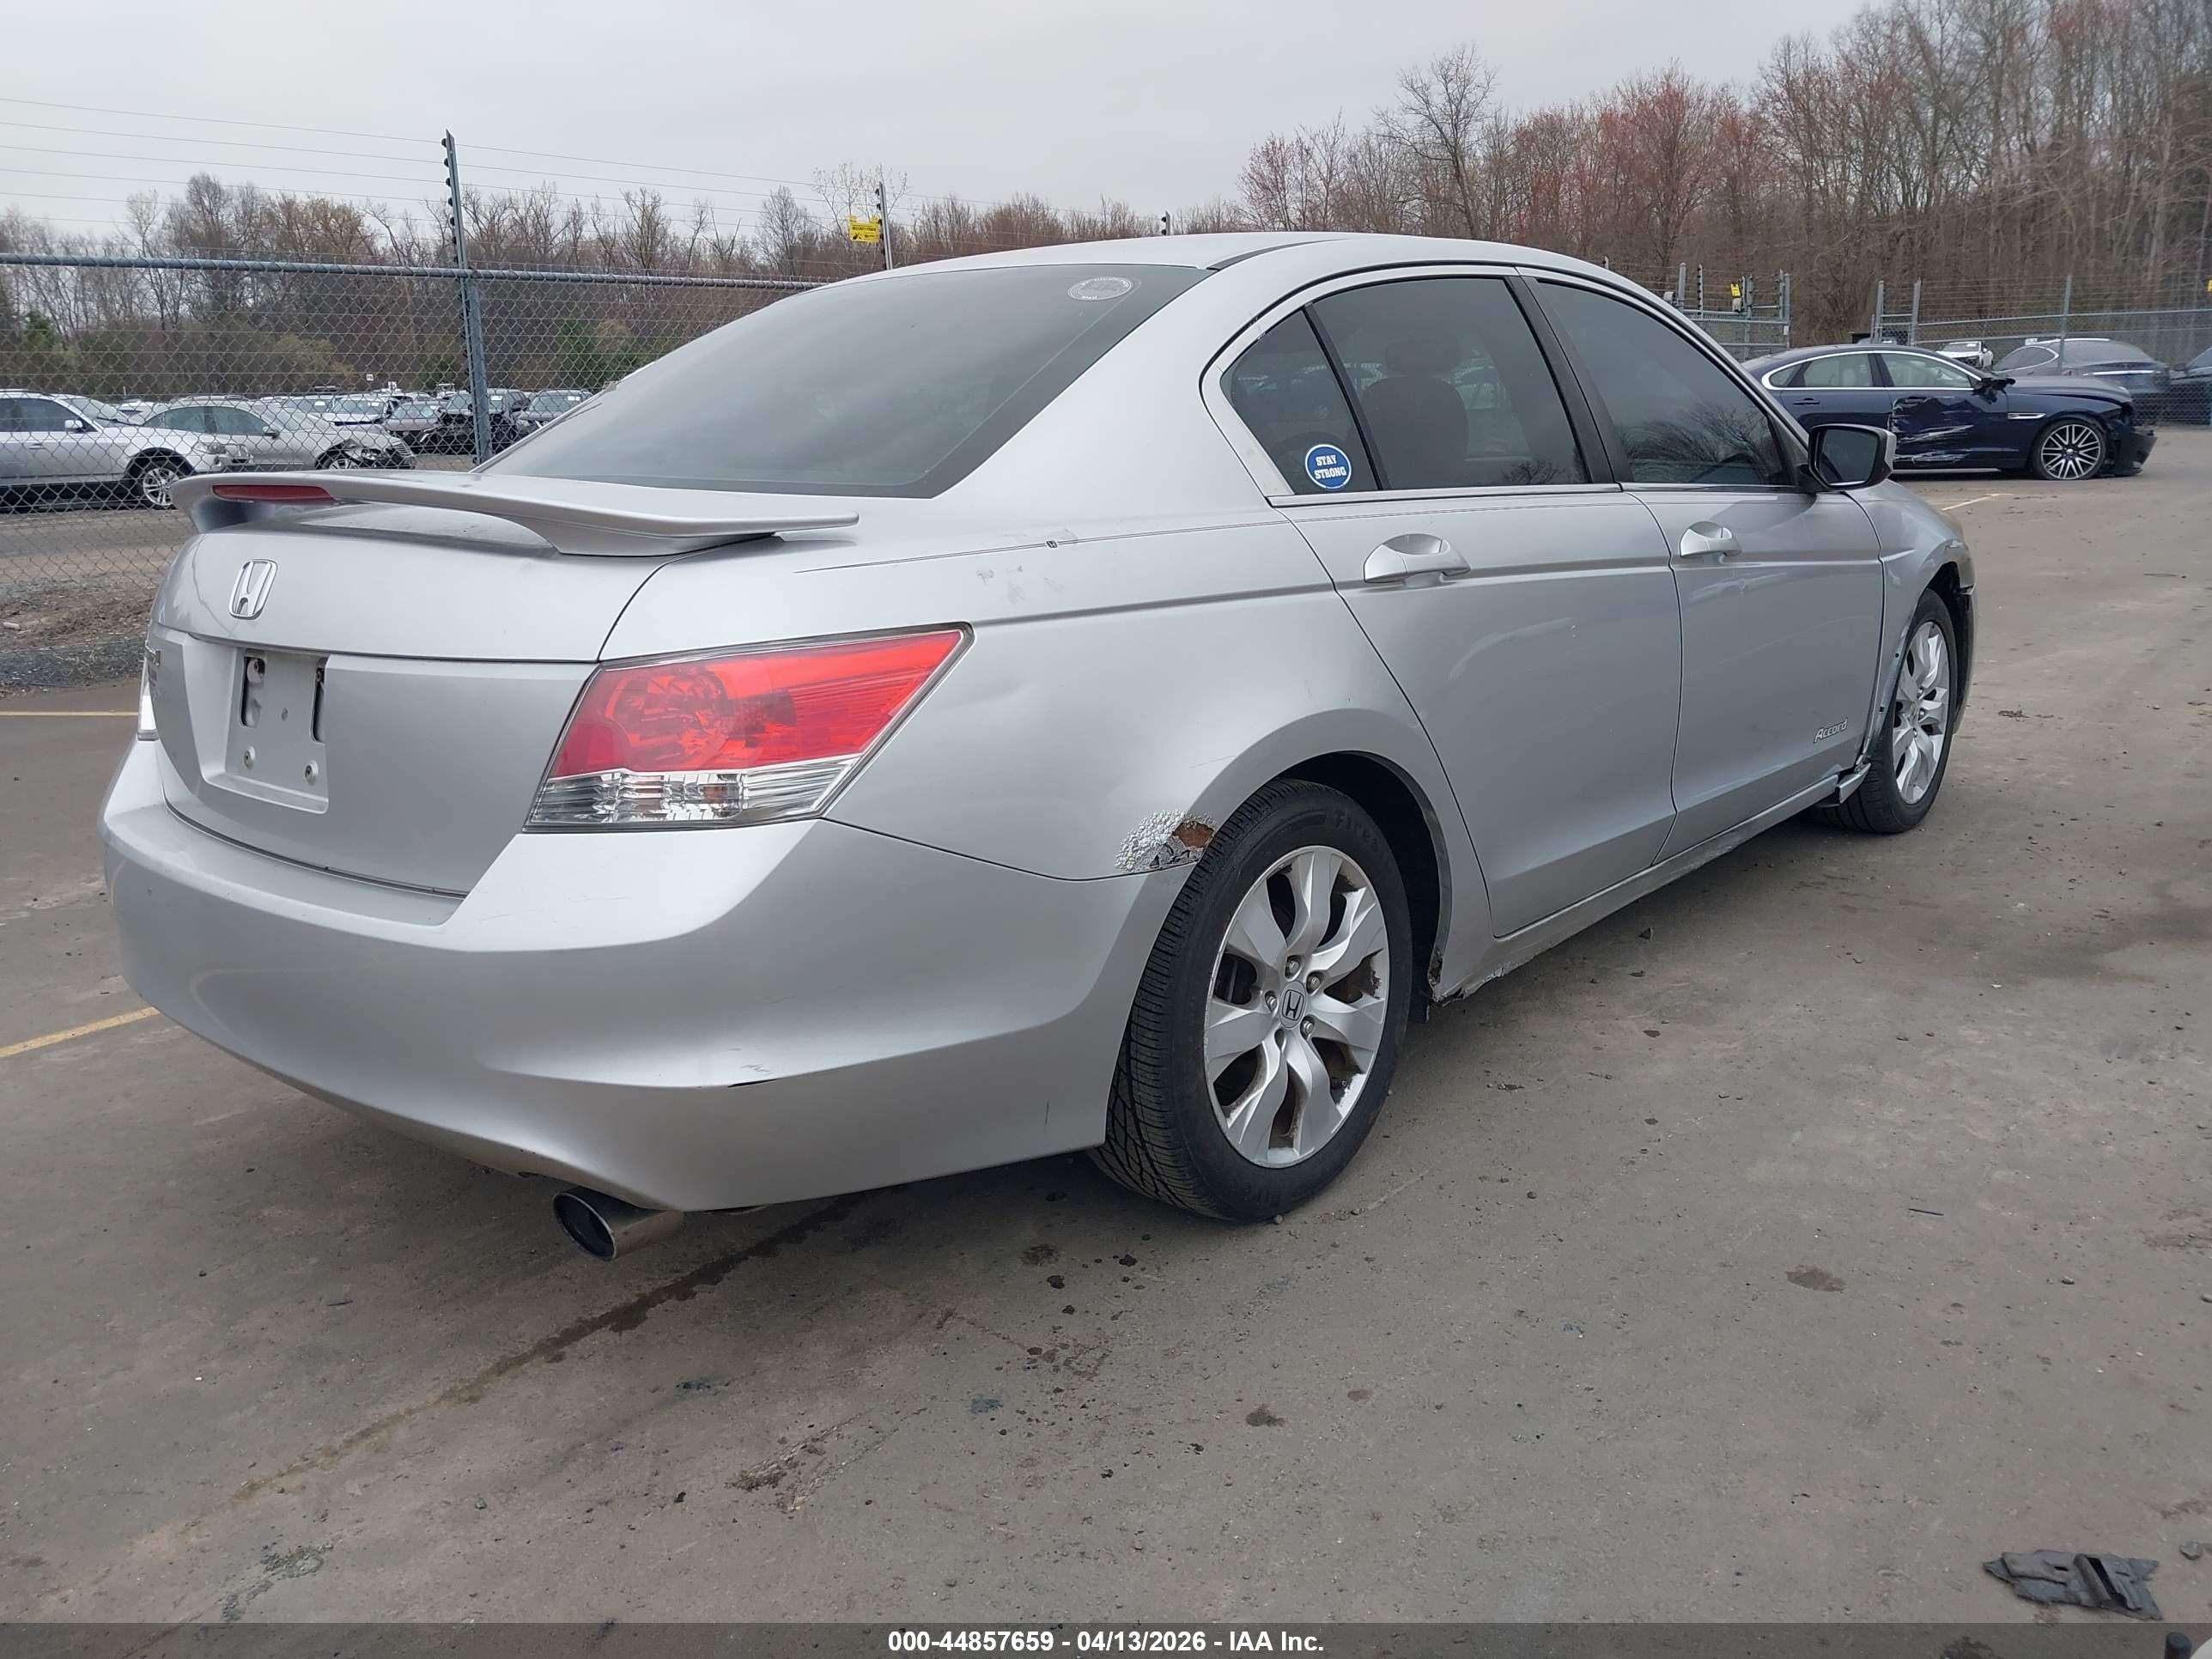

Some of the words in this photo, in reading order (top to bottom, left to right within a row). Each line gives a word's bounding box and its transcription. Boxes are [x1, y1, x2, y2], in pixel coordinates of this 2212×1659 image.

[1316, 454, 1337, 466] STAY
[1314, 466, 1346, 479] STRONG
[1814, 718, 1848, 743] Accord
